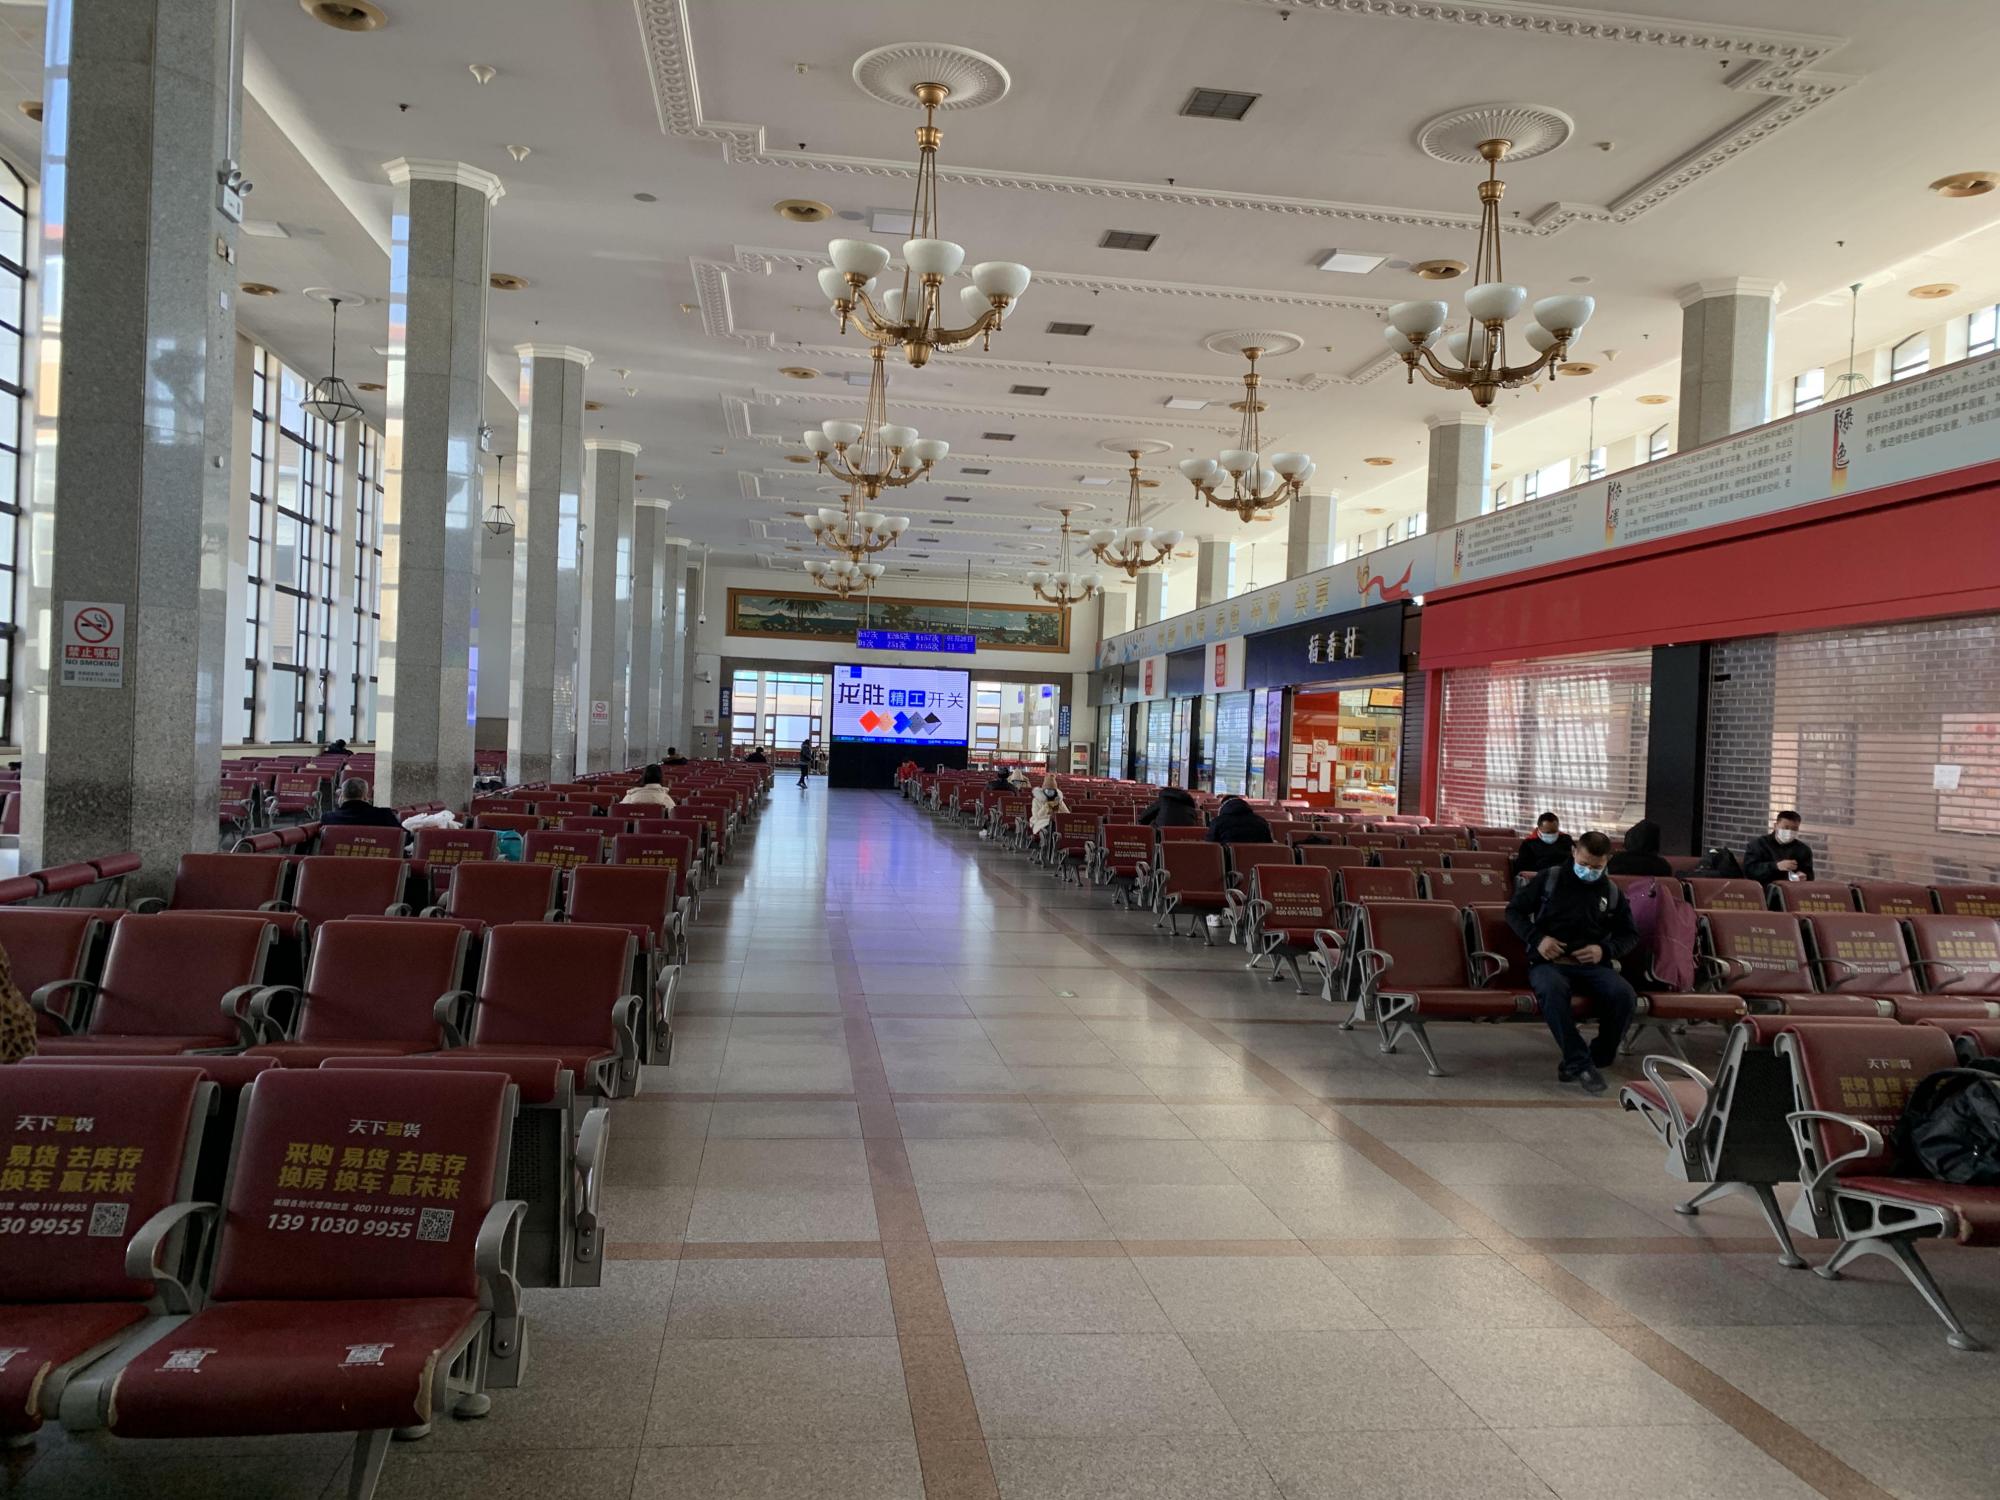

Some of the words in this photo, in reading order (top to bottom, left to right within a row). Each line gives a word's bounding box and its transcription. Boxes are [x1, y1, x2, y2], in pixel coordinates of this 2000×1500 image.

[1294, 577, 1330, 618] 共享
[68, 646, 118, 659] 禁止吸烟
[1308, 627, 1356, 664] 稻香村
[79, 660, 119, 668] SMOKING
[15, 1115, 96, 1133] 天下易货
[347, 1119, 424, 1138] 天下易货
[6, 1145, 60, 1168] 易货
[67, 1146, 144, 1169] 去库存
[284, 1142, 335, 1166] 采购
[339, 1147, 390, 1171] 易货
[395, 1151, 468, 1176] 去库存
[0, 1168, 54, 1192] 换车
[58, 1171, 137, 1194] 赢未来
[277, 1166, 329, 1191] 换房
[333, 1170, 384, 1194] 换车
[388, 1173, 461, 1200] 赢未来
[352, 1204, 370, 1214] 400
[373, 1205, 390, 1215] 118
[392, 1206, 416, 1216] 9955
[28, 1218, 84, 1235] 9955
[266, 1213, 305, 1231] 139
[308, 1215, 360, 1235] 1030
[361, 1220, 413, 1239] 9955
